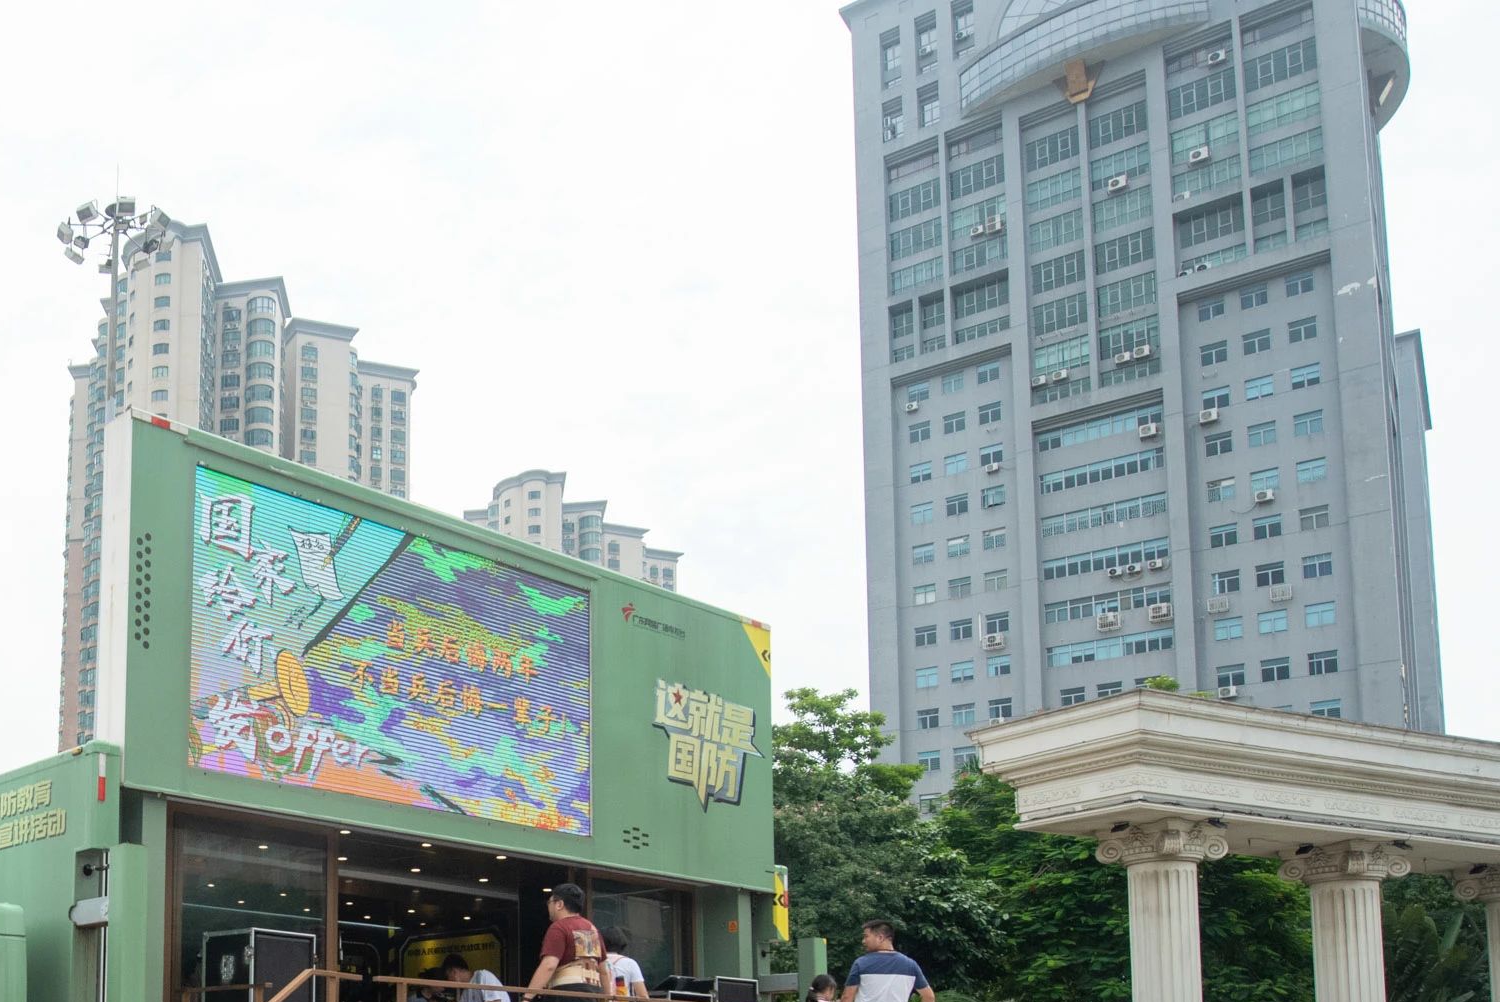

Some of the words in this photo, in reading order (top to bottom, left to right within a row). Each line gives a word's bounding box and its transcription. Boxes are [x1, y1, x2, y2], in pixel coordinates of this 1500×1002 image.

[386, 617, 539, 684] 当兵后悔两年
[655, 679, 760, 754] 这就是
[668, 732, 739, 806] 国防
